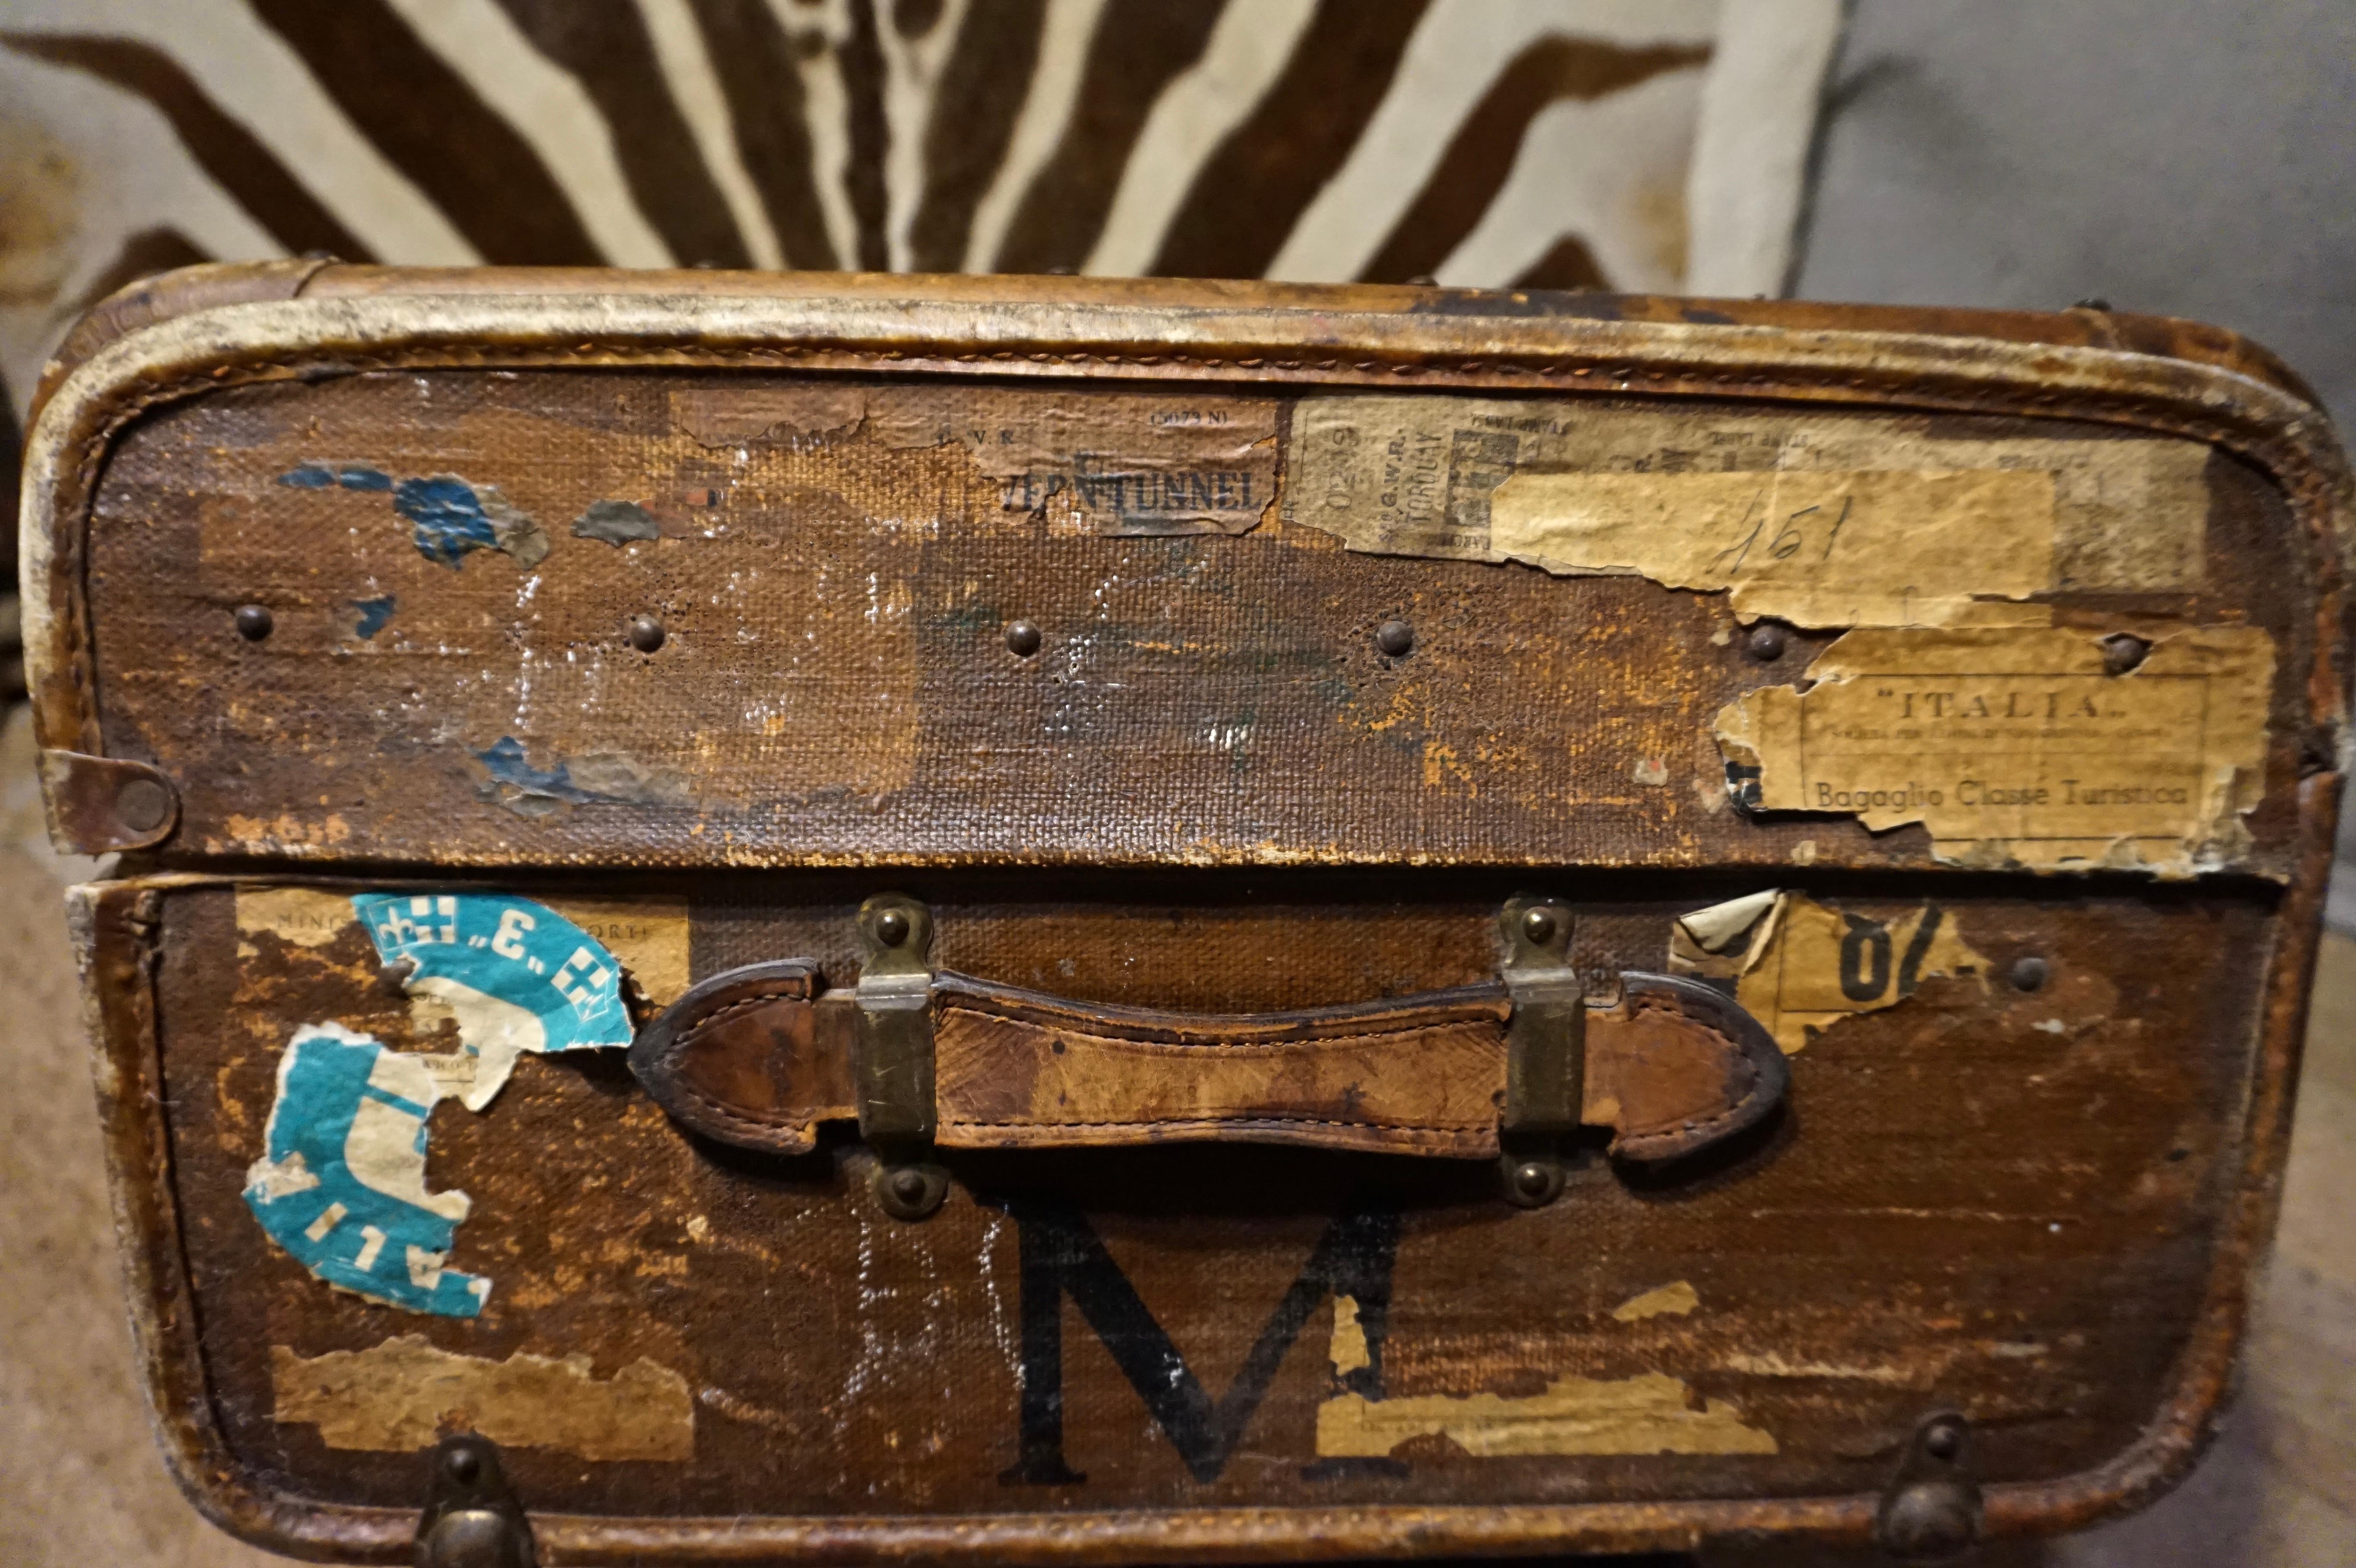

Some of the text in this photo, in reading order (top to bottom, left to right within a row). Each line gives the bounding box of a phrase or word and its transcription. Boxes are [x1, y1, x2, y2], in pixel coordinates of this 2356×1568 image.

[1403, 432, 1441, 522] TORQUAY
[1816, 780, 1944, 812] Bagaglio
[2061, 779, 2188, 806] Turistica
[974, 1185, 1410, 1486] M
